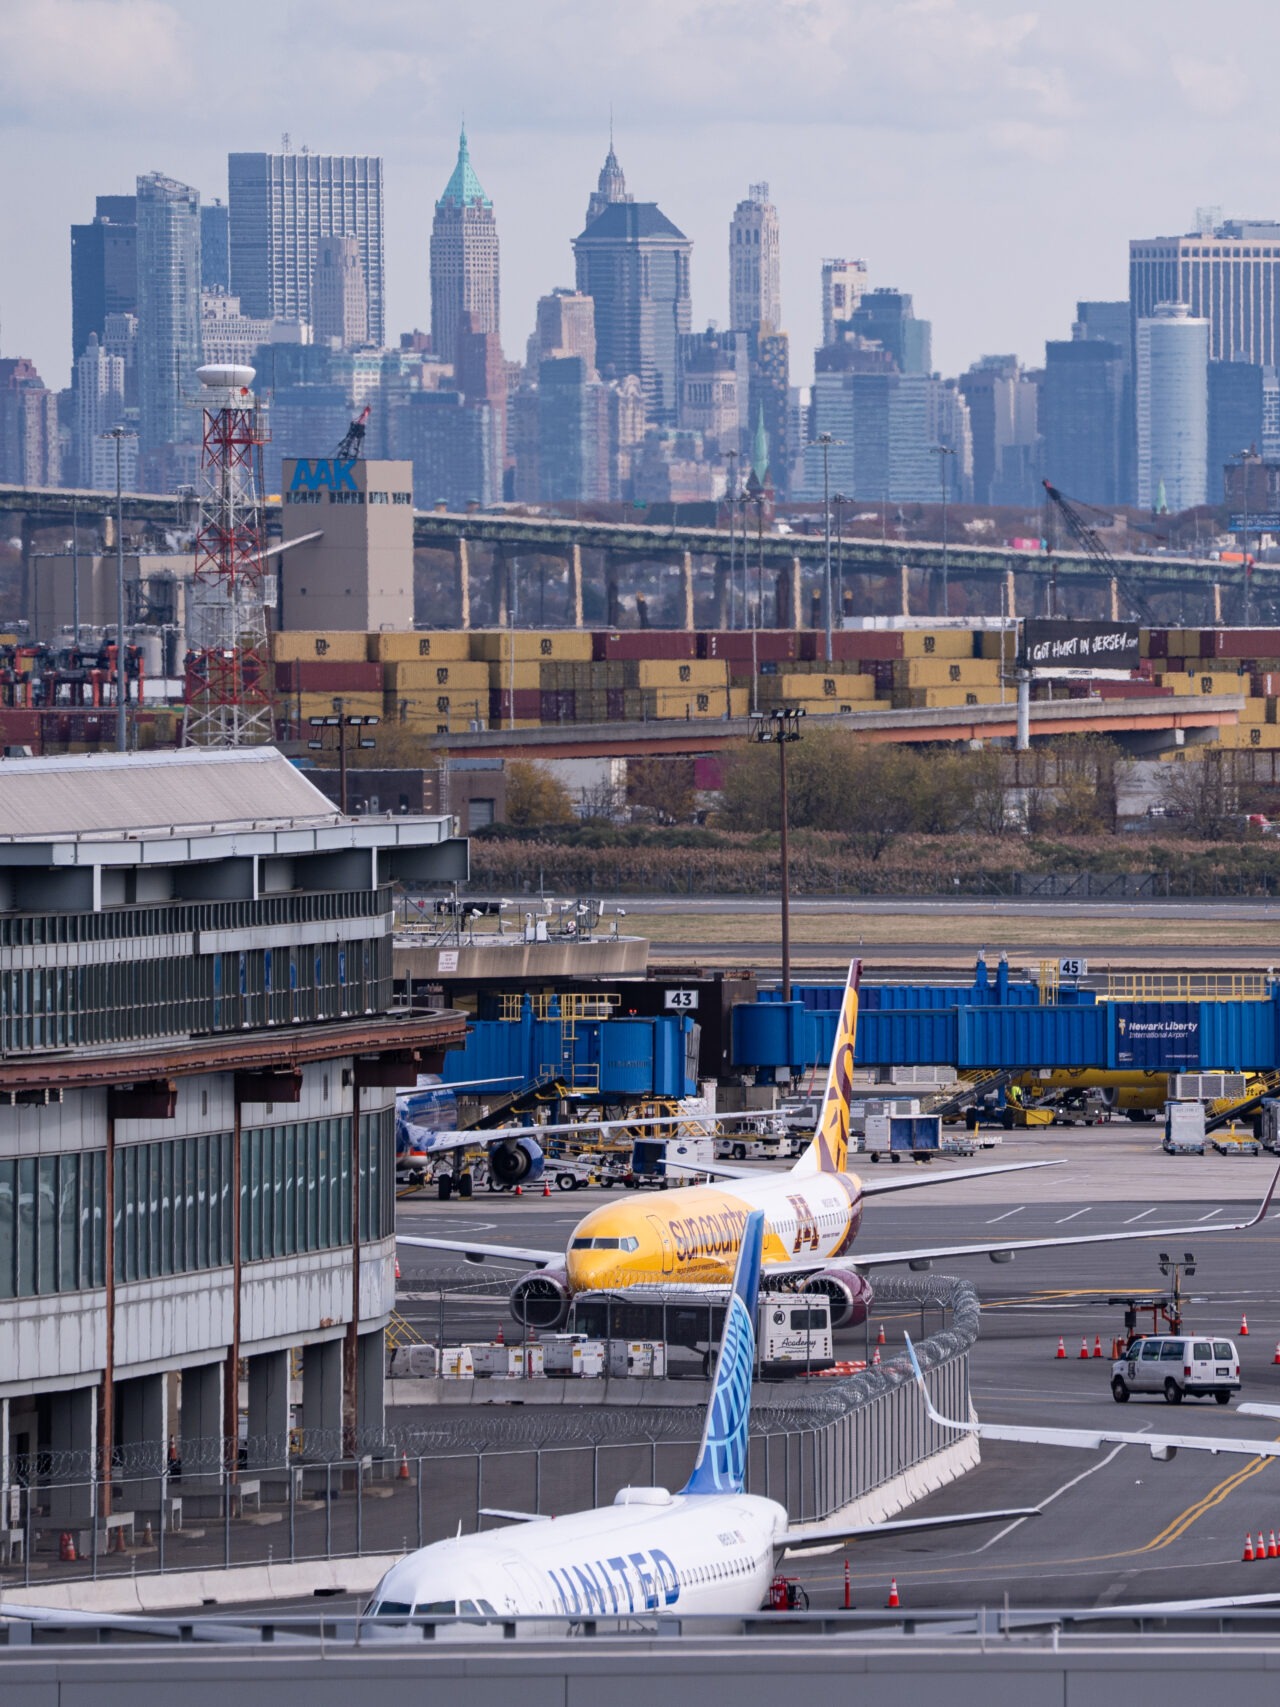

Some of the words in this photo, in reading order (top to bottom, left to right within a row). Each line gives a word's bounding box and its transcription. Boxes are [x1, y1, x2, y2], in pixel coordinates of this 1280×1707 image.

[290, 460, 358, 491] AAK
[1034, 641, 1051, 660] GOT
[1053, 638, 1078, 657] HURT
[1080, 637, 1089, 655] IN
[1062, 961, 1079, 974] 45
[672, 993, 692, 1006] 43
[1129, 1022, 1163, 1031] Newark
[1165, 1022, 1198, 1032] Liberty
[782, 1337, 816, 1349] Academy
[548, 1549, 681, 1615] UNITED
